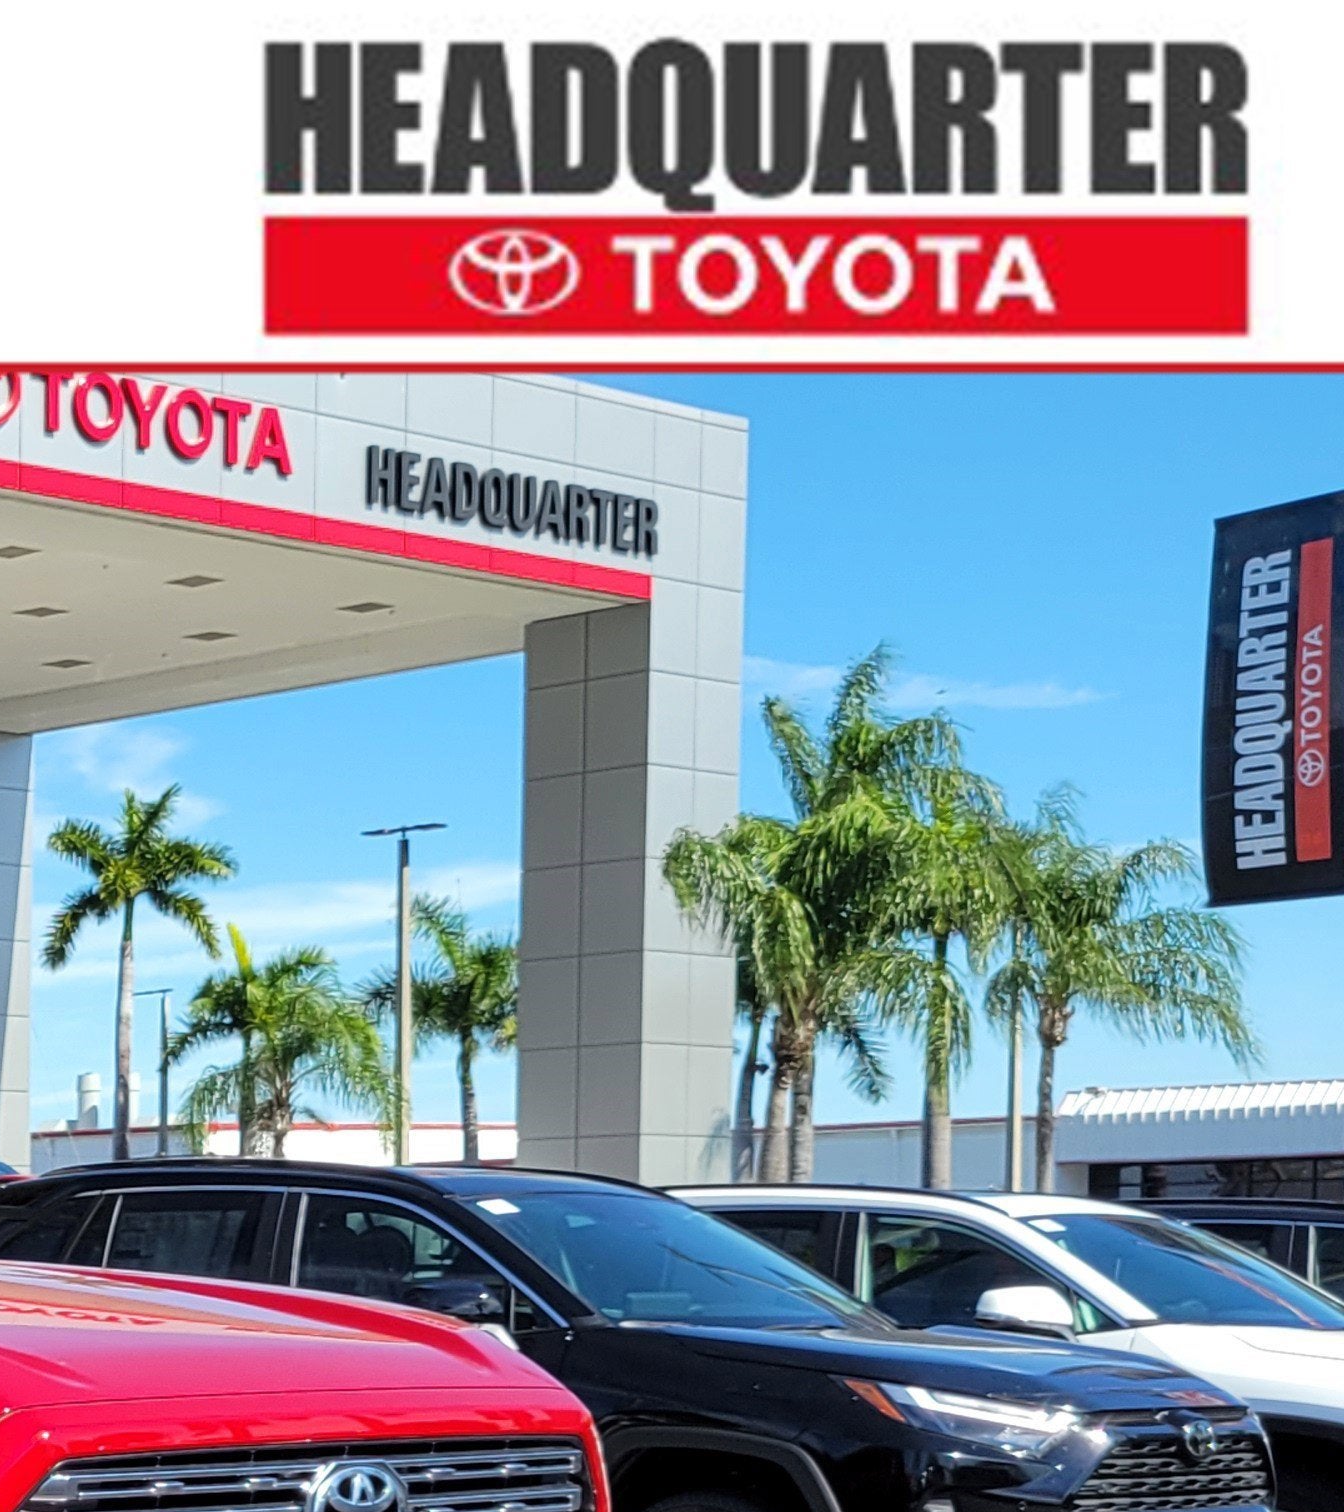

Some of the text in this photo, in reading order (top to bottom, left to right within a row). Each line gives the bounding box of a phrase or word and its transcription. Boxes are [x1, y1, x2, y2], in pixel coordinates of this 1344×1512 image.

[31, 373, 293, 476] TOYOTA
[365, 445, 659, 557] HEADQUARTER
[1233, 548, 1293, 871] HEADQUARTER
[1300, 623, 1324, 746] TOYOTA
